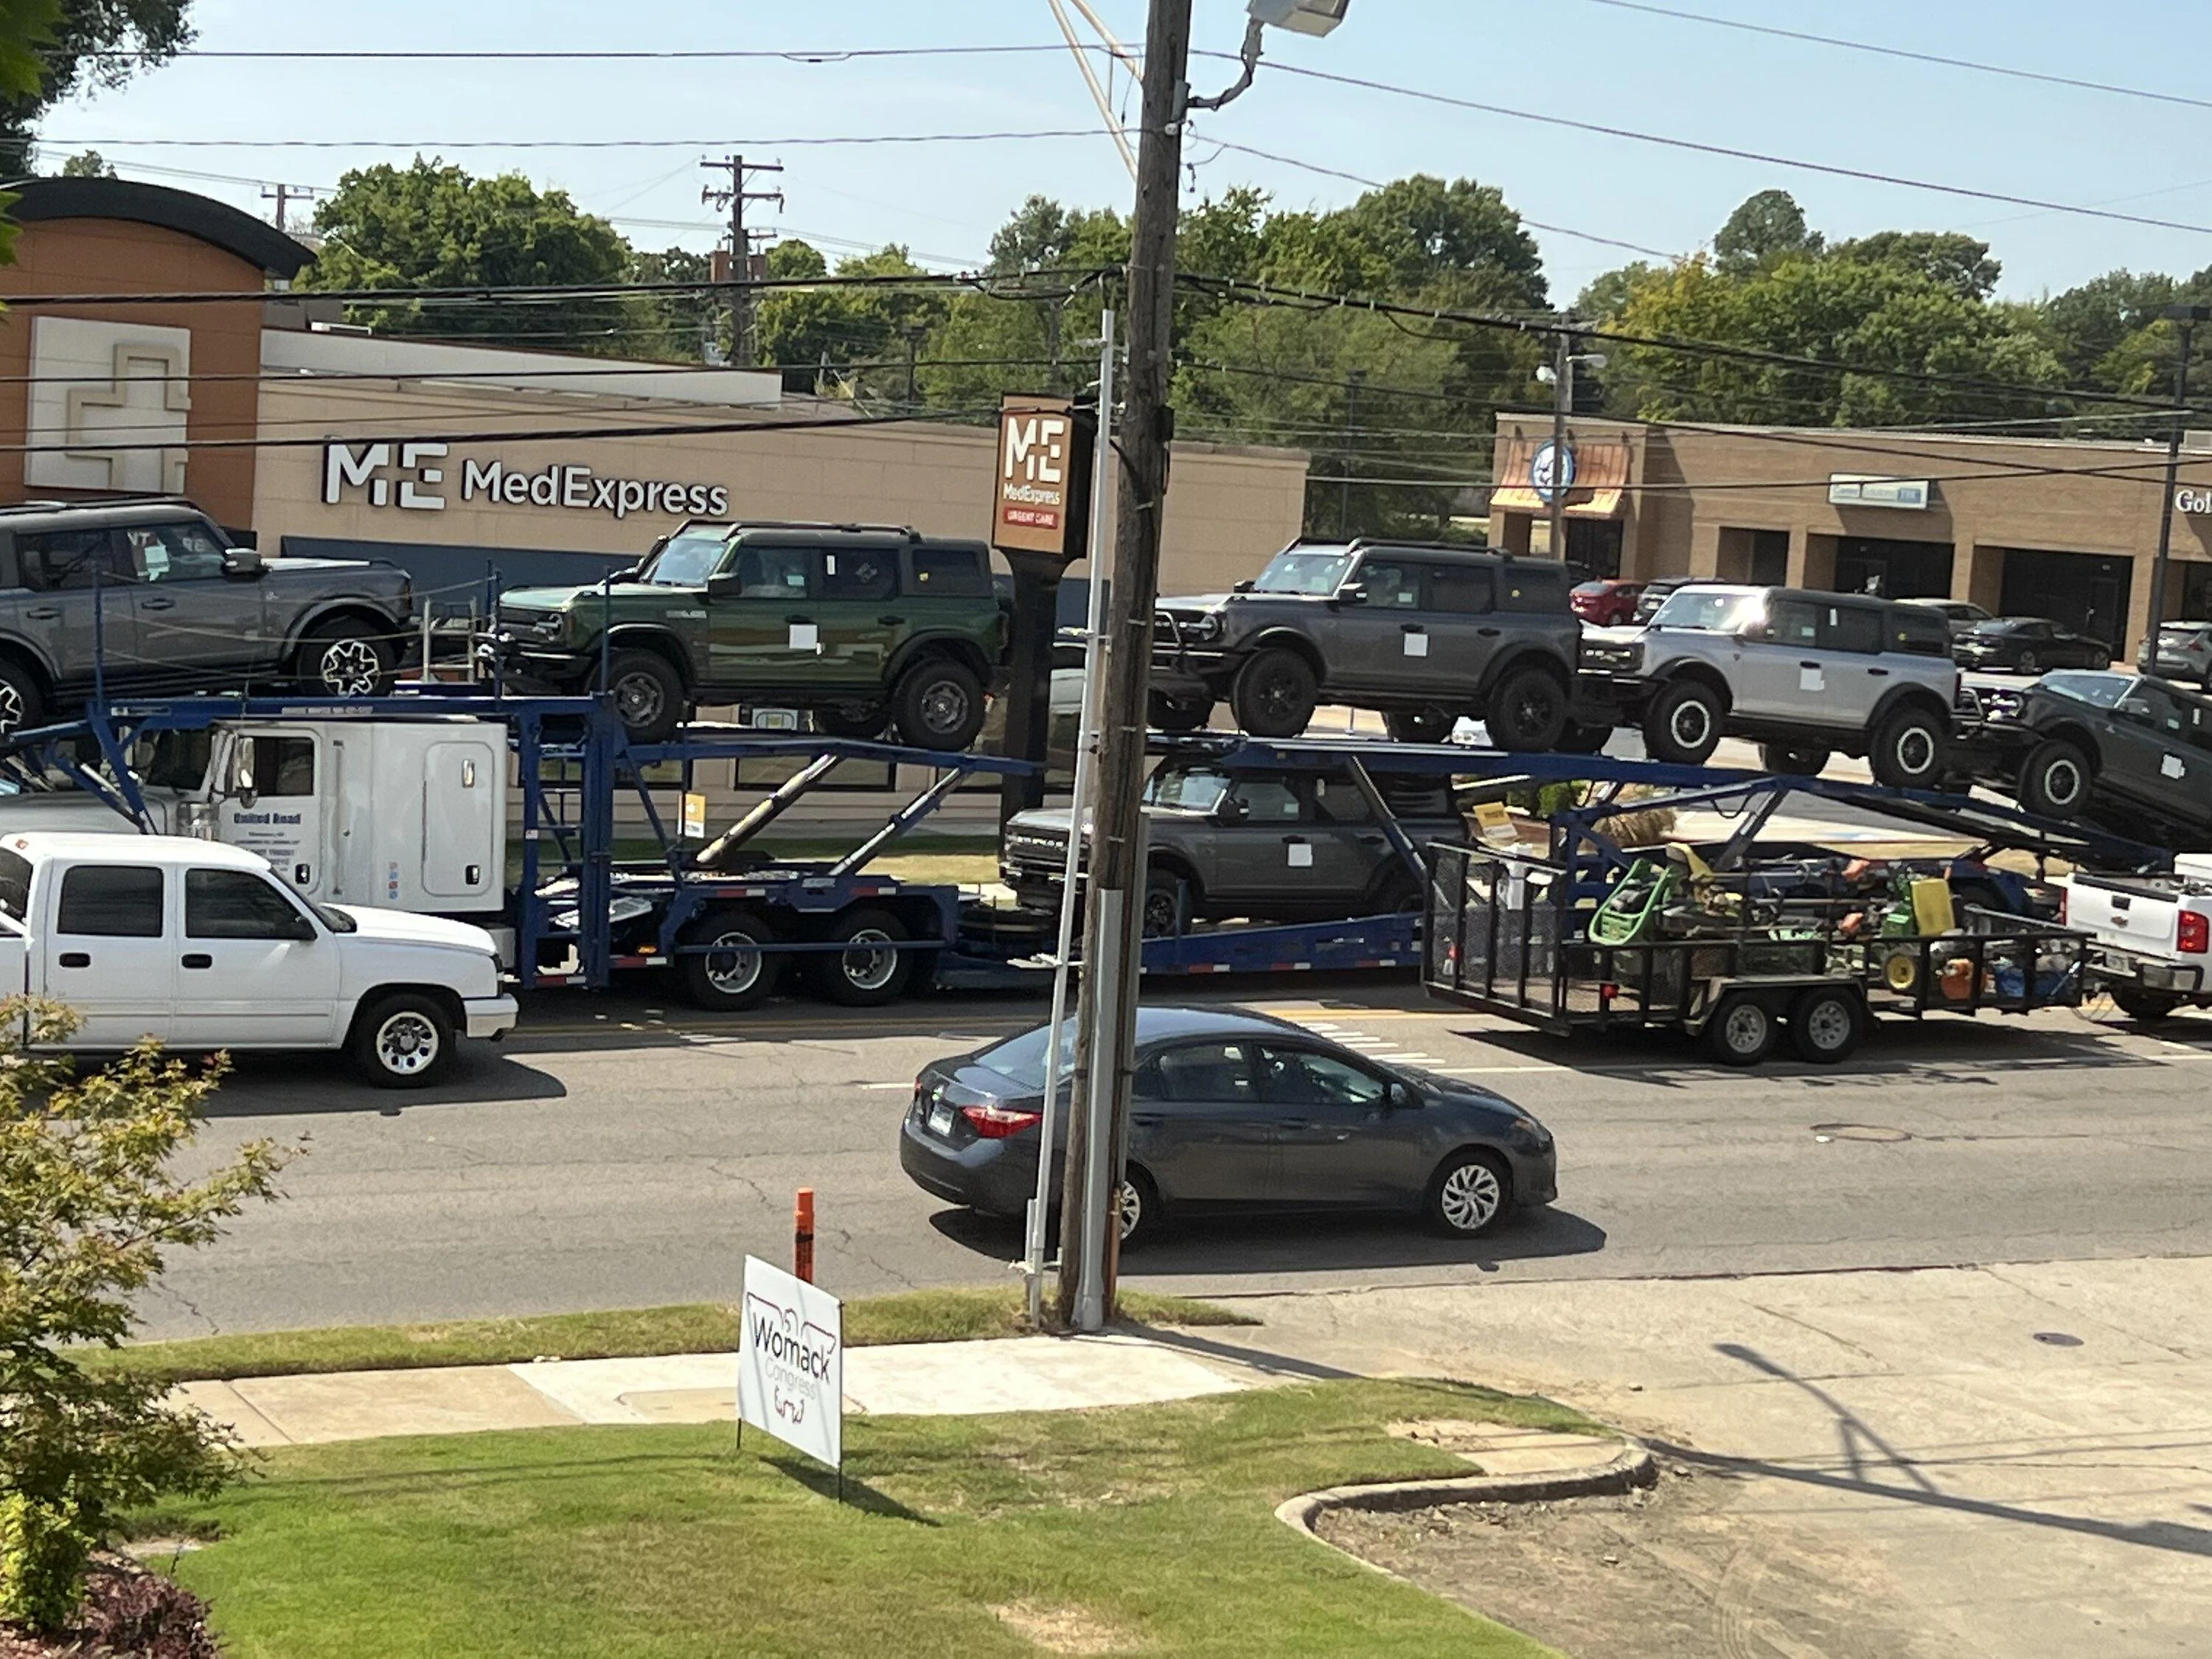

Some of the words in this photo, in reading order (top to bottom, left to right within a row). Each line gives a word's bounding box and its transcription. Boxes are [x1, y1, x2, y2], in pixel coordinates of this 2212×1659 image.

[323, 443, 448, 509] ME
[462, 459, 728, 518] MedExpress
[1004, 417, 1065, 484] ME
[1003, 482, 1060, 506] MedExpress
[753, 1312, 830, 1385] Womack
[765, 1356, 817, 1399] Congress
